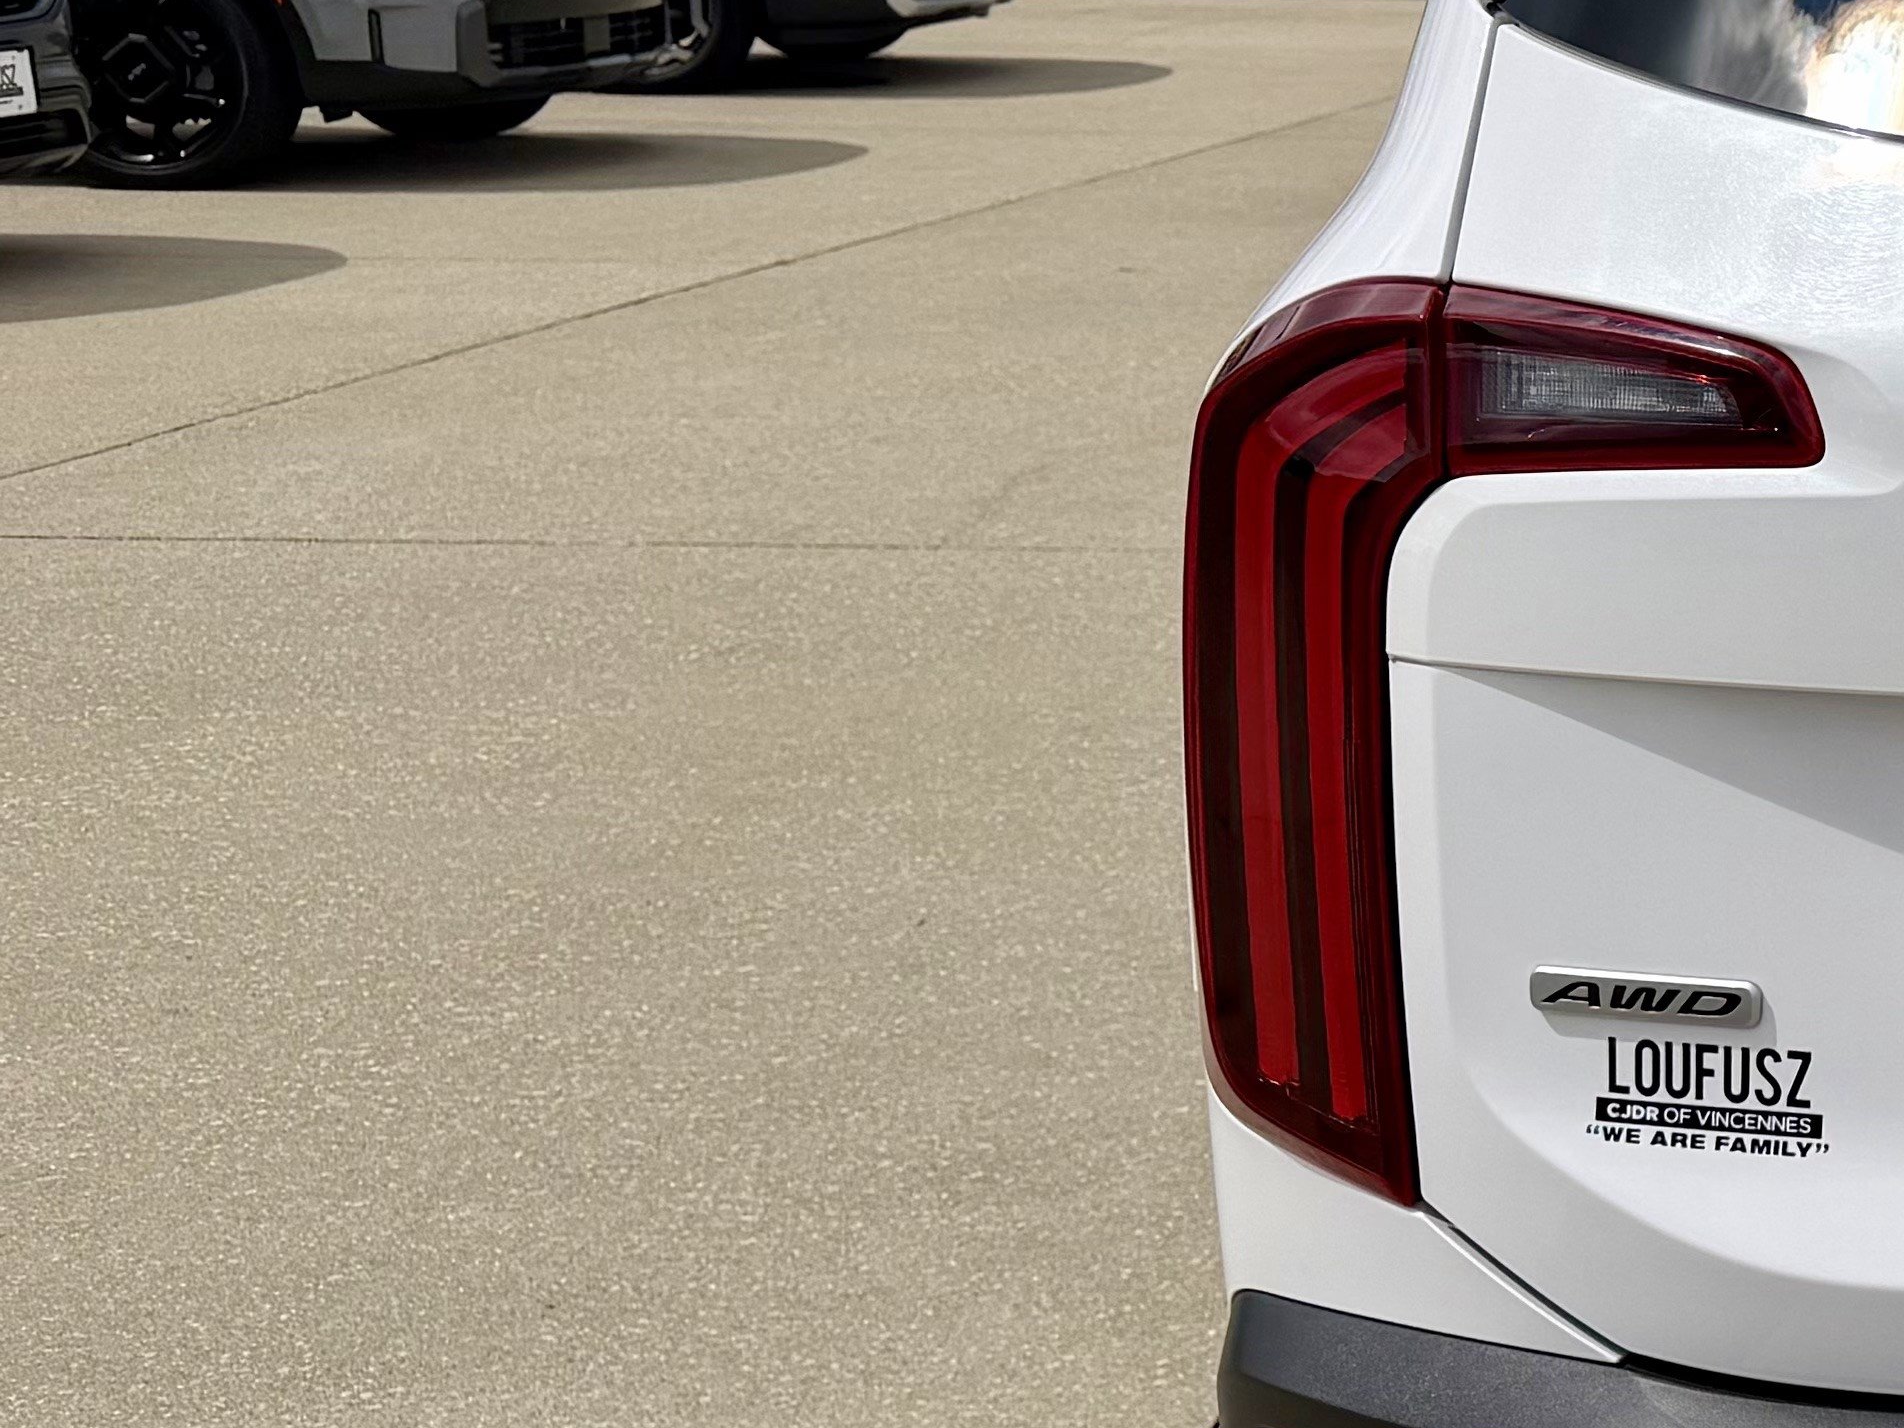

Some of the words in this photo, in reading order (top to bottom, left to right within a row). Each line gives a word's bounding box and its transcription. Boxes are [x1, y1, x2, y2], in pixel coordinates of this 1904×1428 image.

[1541, 981, 1742, 1017] AWD
[1605, 1102, 1660, 1123] CJDR
[1663, 1106, 1691, 1125] OF
[1695, 1109, 1812, 1134] VINCENNES
[1649, 1129, 1706, 1151] ARE
